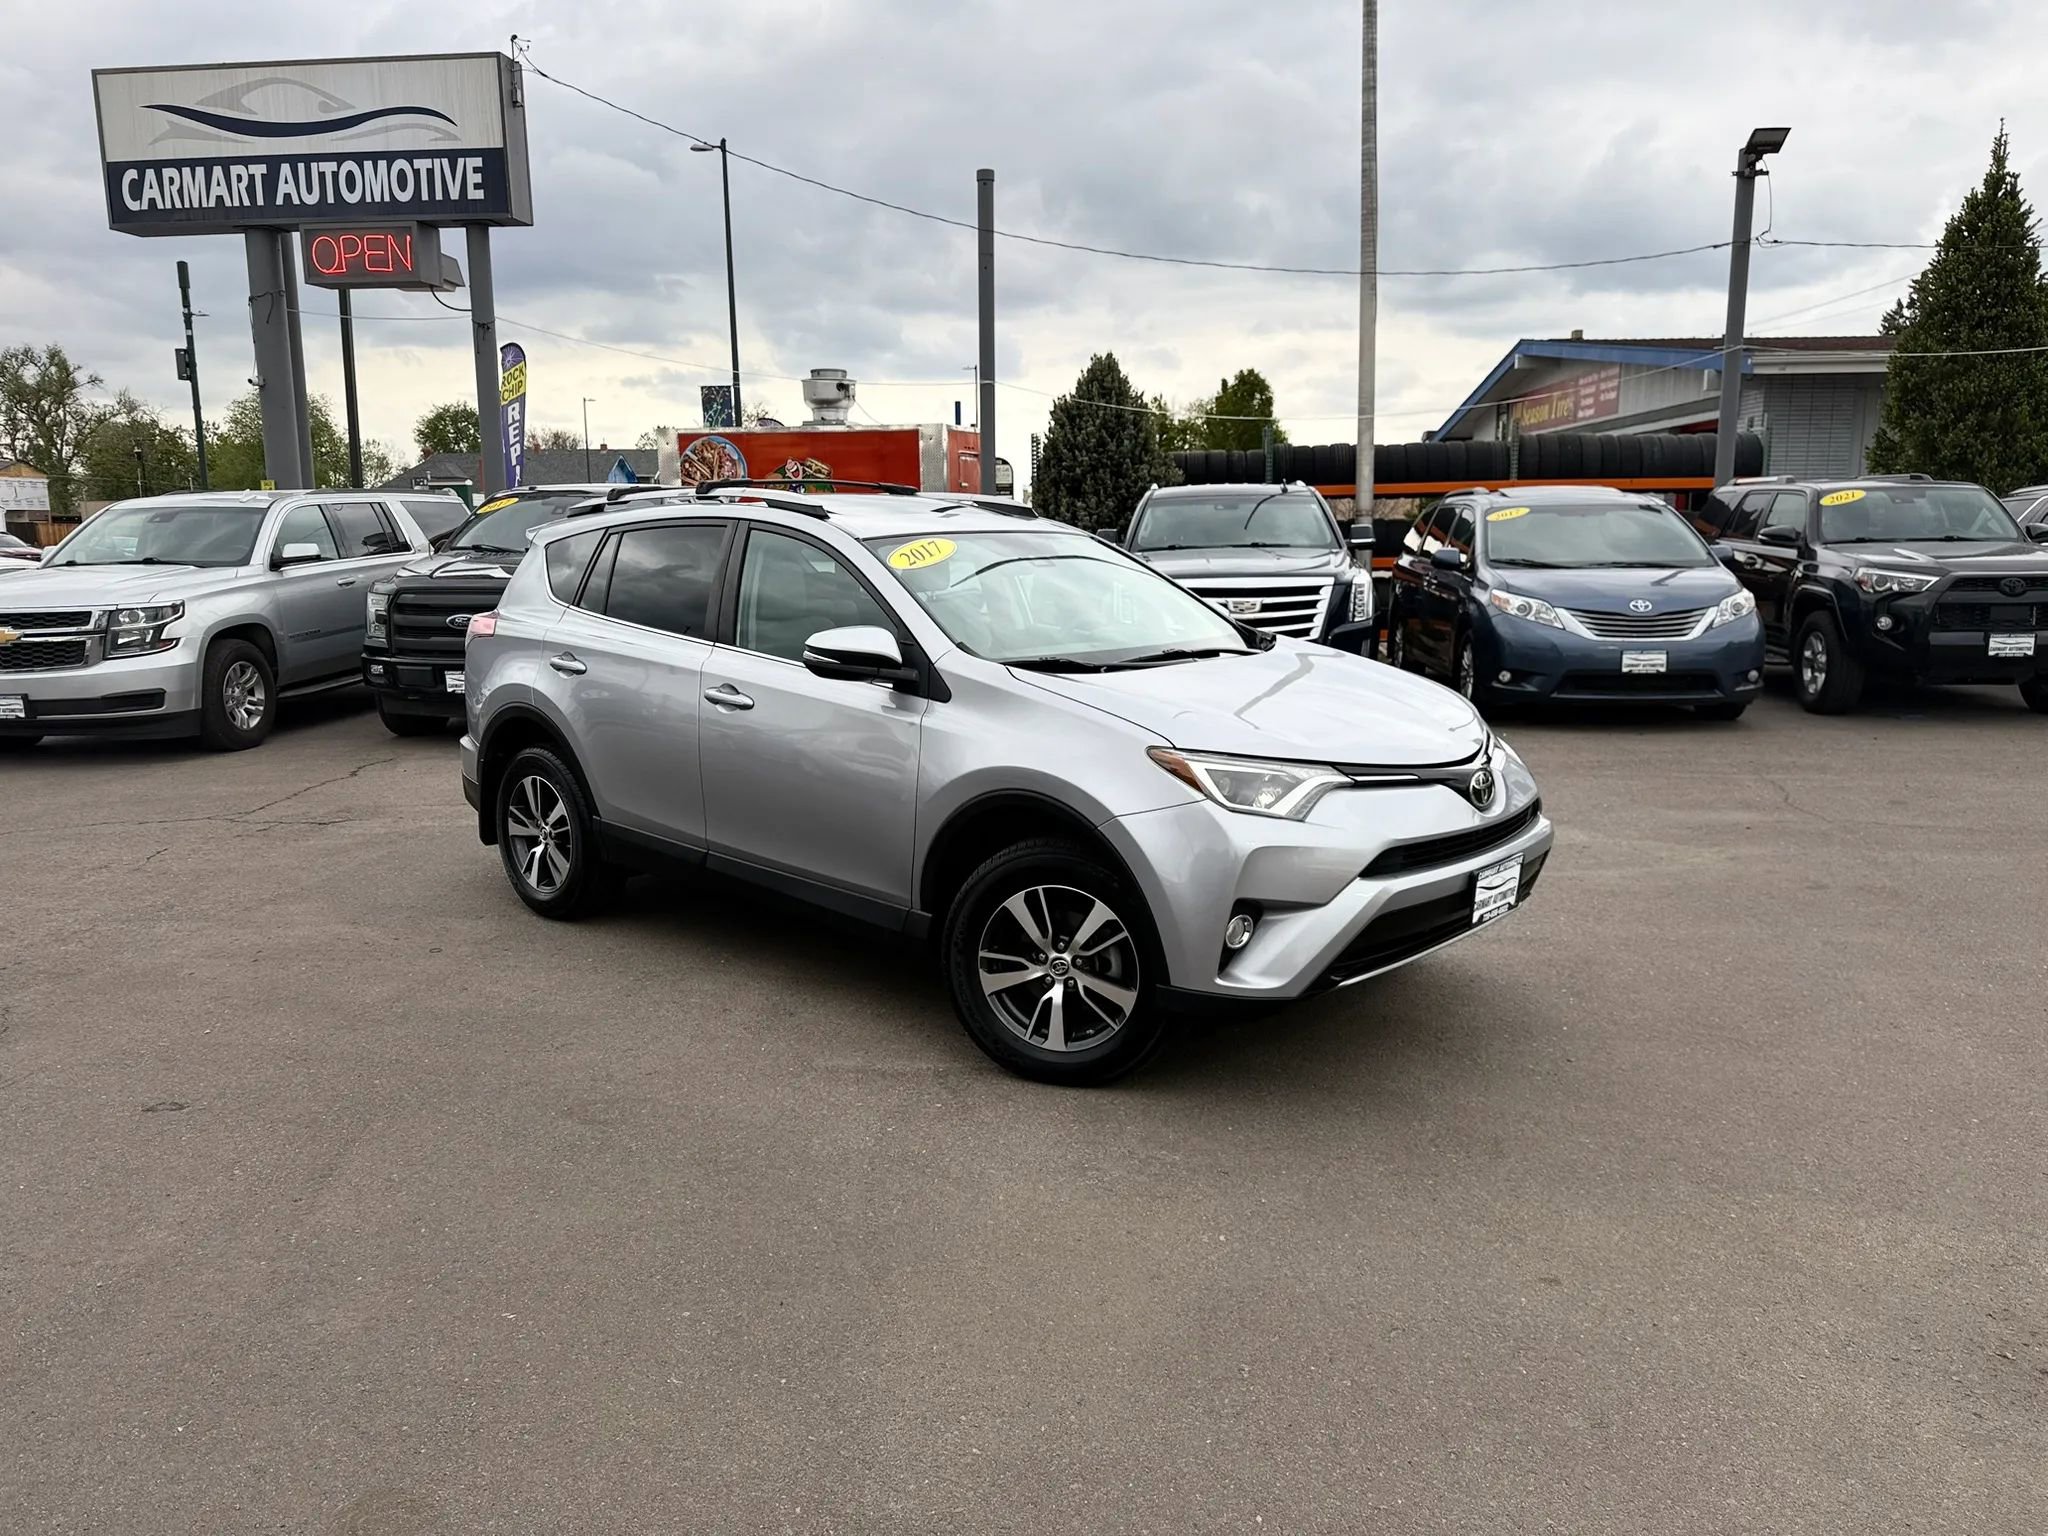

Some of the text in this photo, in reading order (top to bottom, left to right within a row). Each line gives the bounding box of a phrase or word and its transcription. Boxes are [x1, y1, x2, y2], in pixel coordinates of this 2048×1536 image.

[121, 156, 486, 211] CARMART AUTOMOTIVE
[311, 233, 414, 274] OPEN
[501, 365, 525, 388] ROCK
[502, 379, 523, 402] CHIP
[1830, 491, 1855, 504] 2021
[899, 540, 942, 566] 2017
